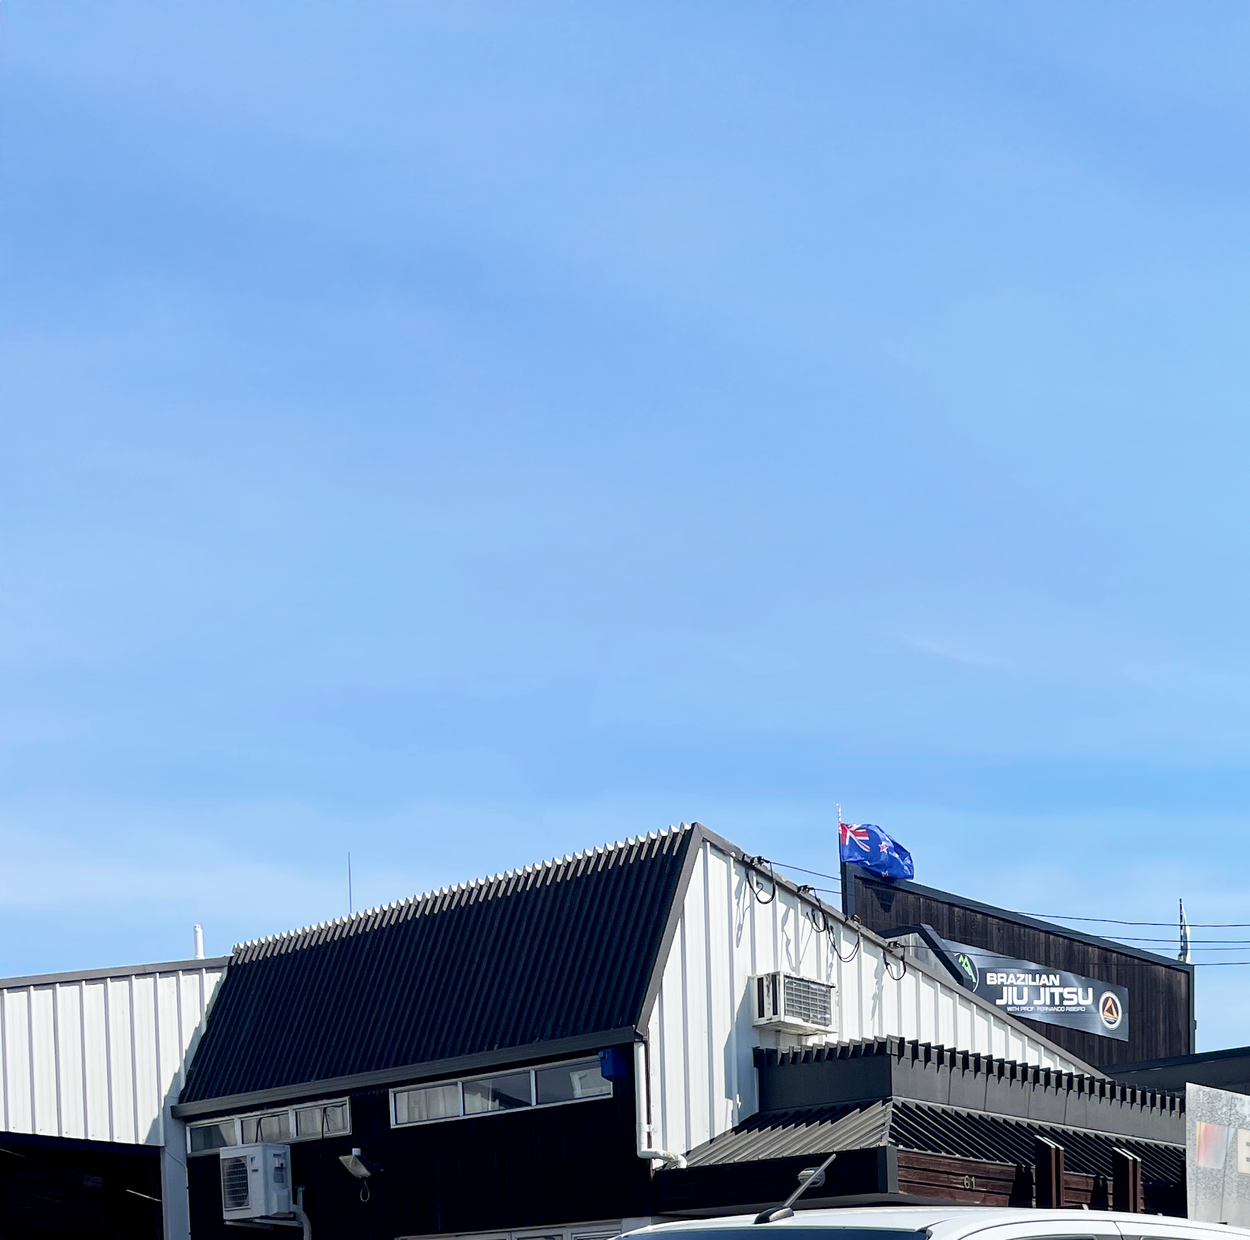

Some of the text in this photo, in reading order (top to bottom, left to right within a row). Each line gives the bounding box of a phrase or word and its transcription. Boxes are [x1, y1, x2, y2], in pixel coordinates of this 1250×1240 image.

[986, 972, 1060, 986] BRAZILIAN
[996, 987, 1093, 1006] JIU JITSU
[963, 1175, 976, 1190] 61
